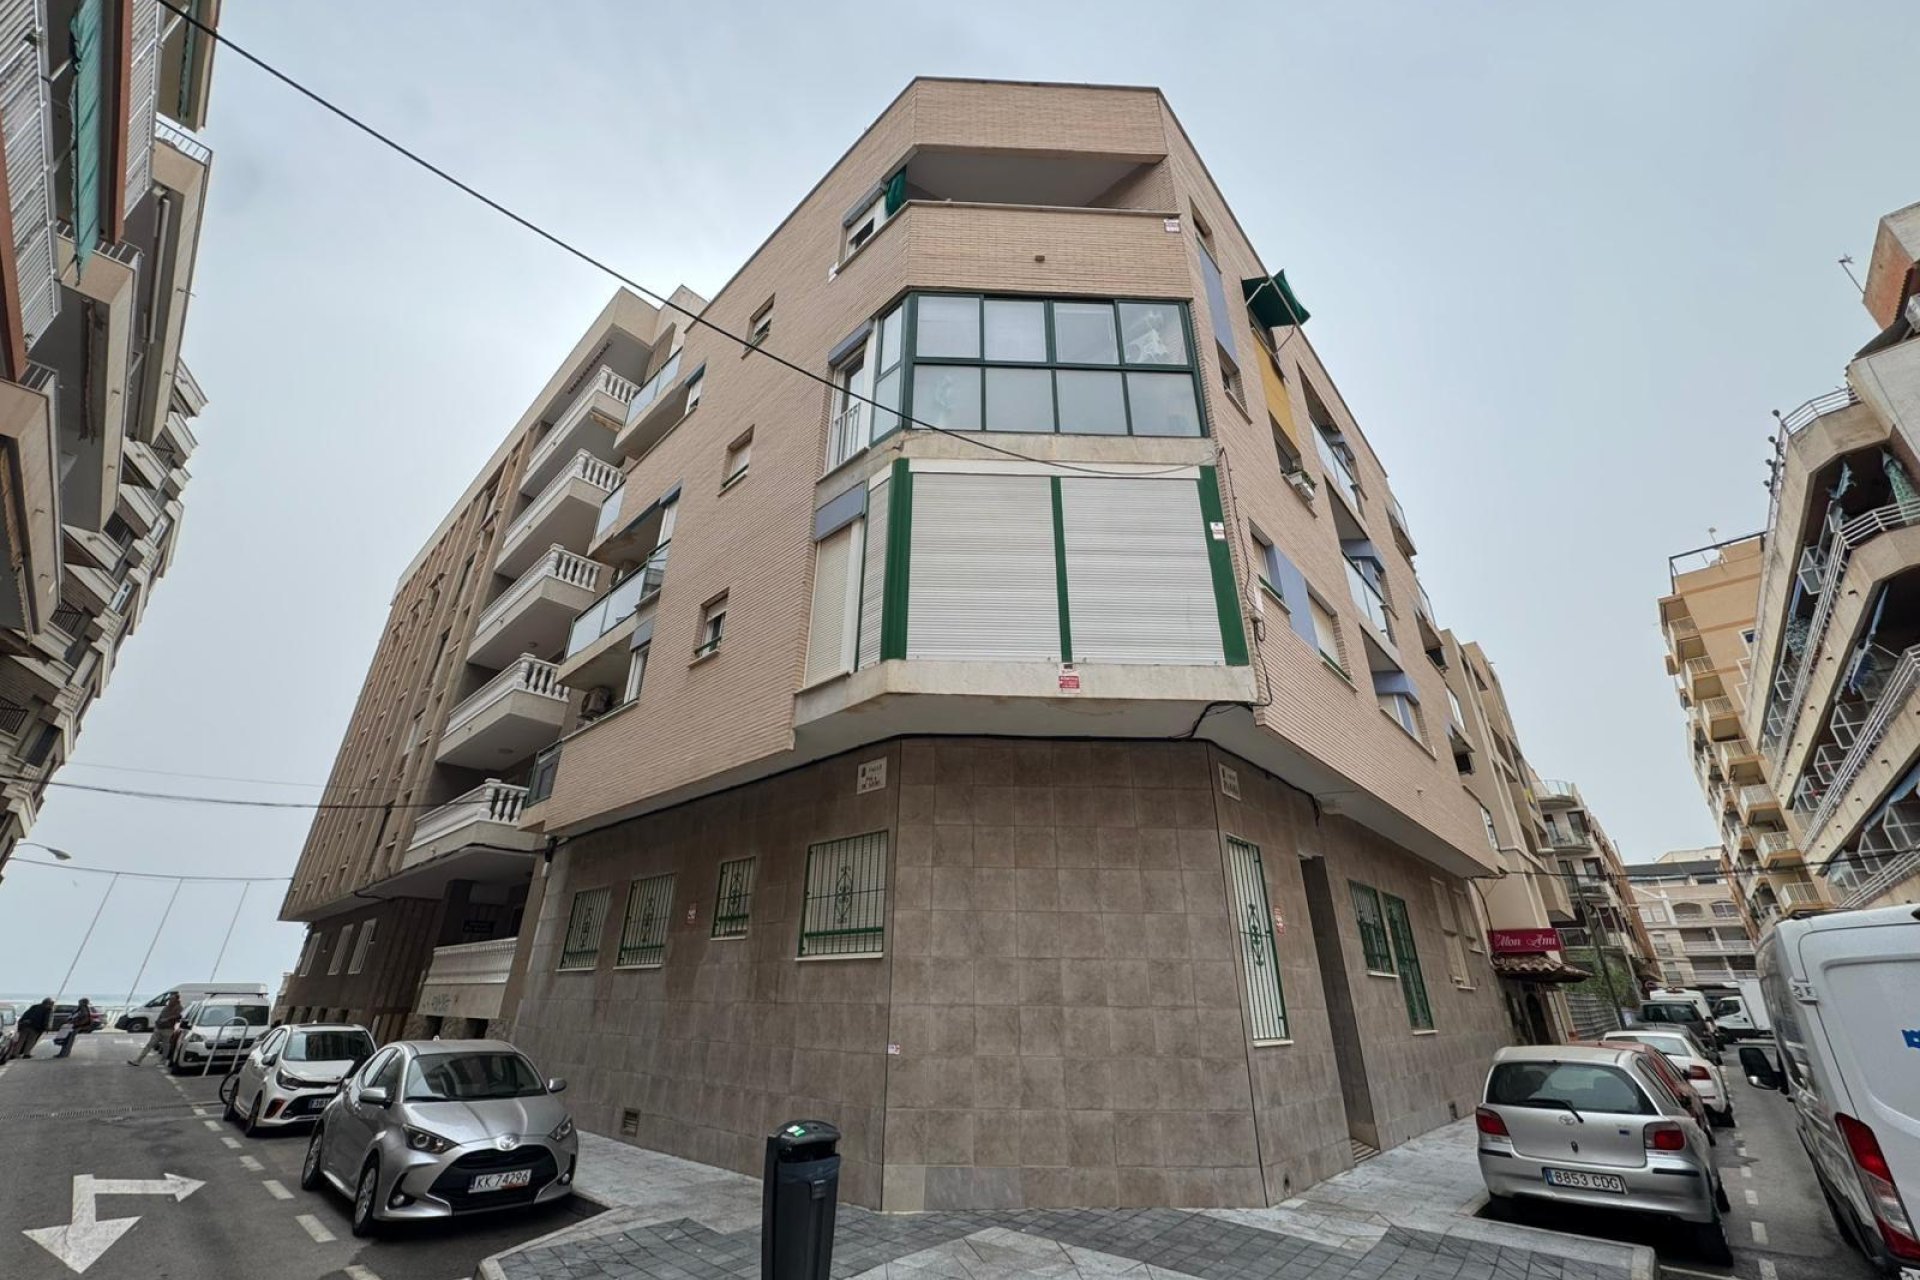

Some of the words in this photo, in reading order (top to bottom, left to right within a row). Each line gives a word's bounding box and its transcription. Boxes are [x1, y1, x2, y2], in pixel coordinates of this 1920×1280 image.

[1495, 934, 1520, 947] Mon
[1526, 934, 1557, 948] Ami
[478, 1175, 491, 1189] KK
[1555, 1171, 1588, 1186] 8853
[1592, 1175, 1619, 1189] CDG
